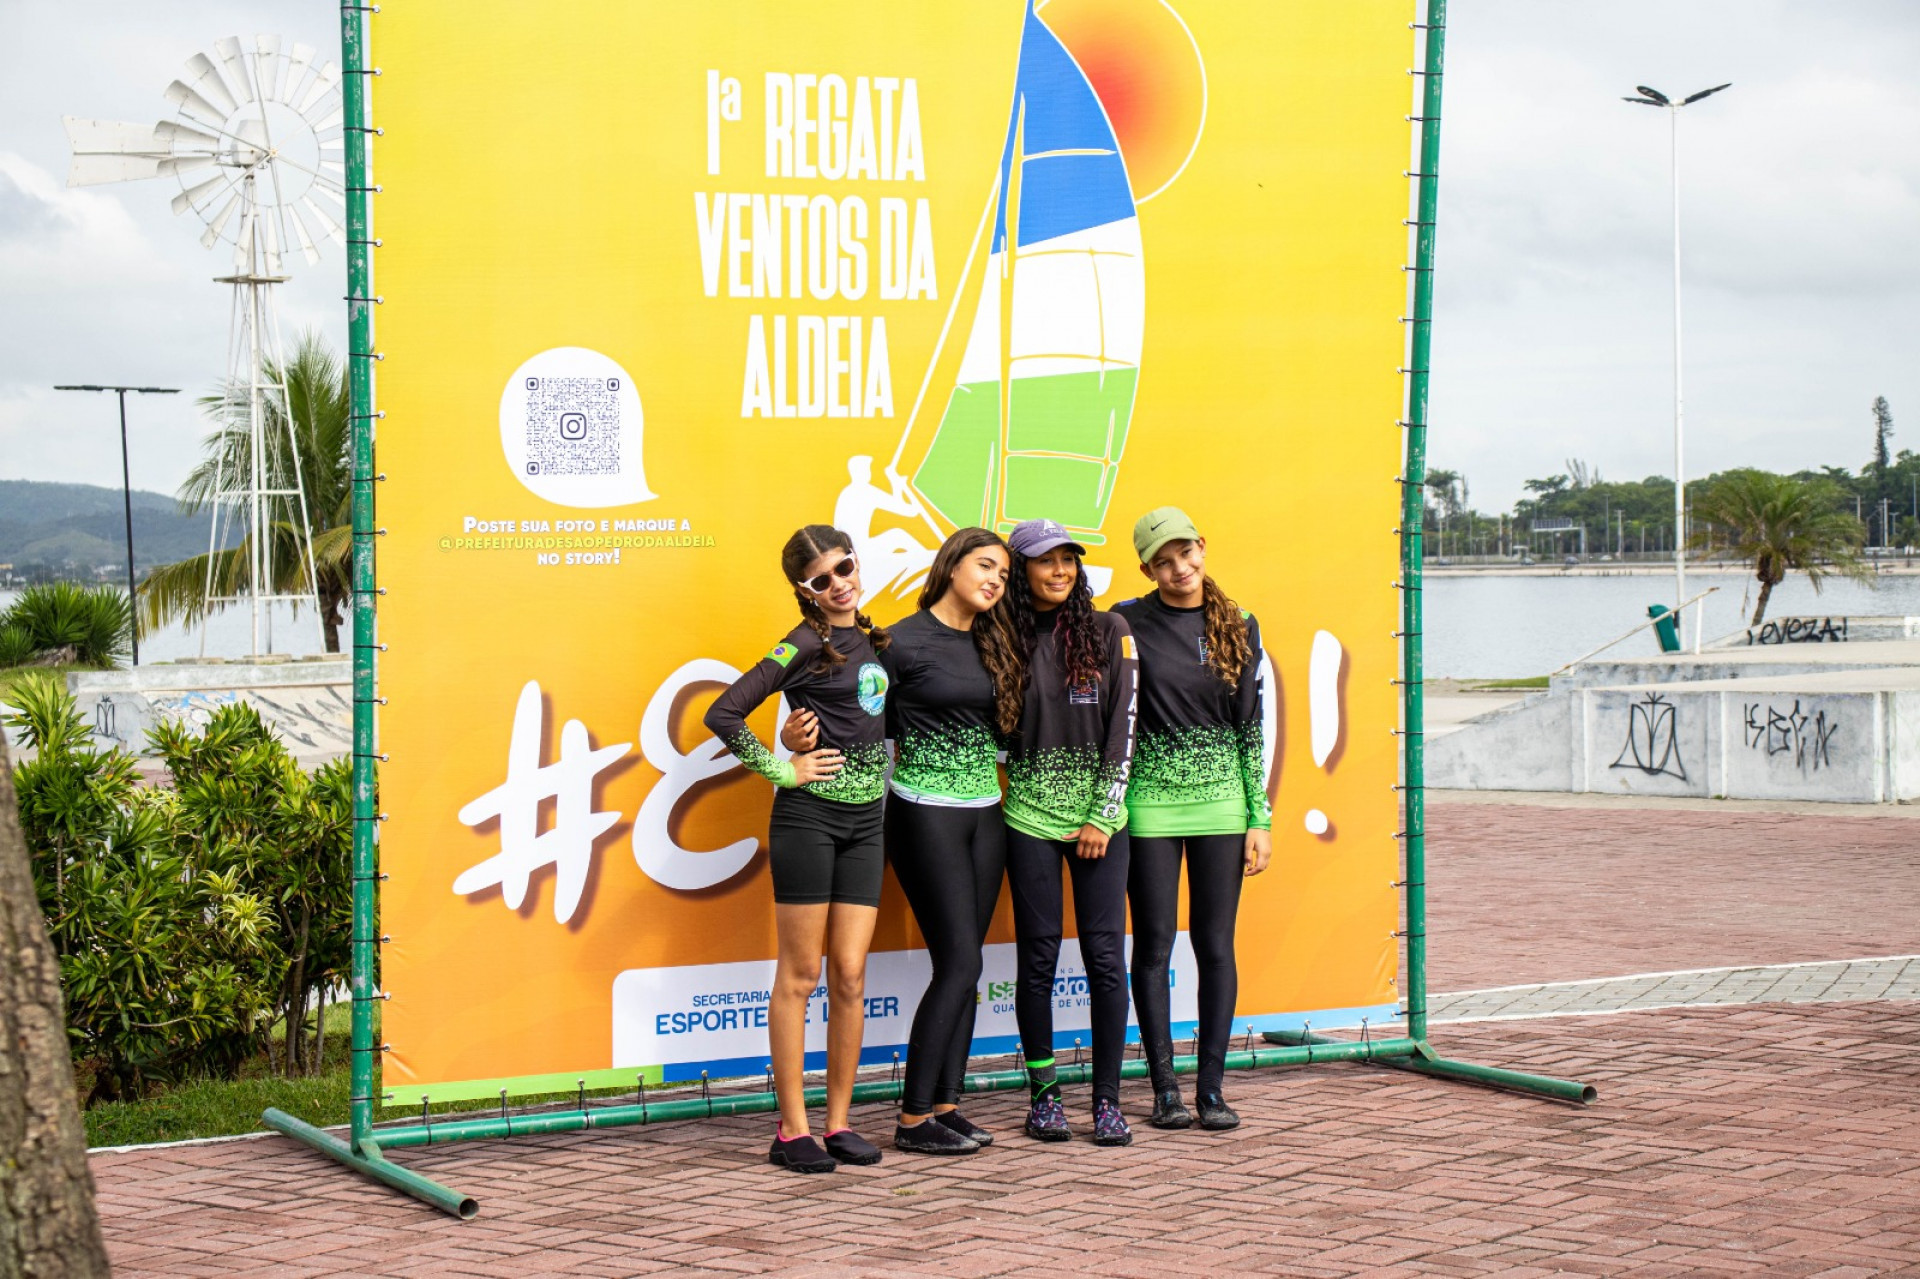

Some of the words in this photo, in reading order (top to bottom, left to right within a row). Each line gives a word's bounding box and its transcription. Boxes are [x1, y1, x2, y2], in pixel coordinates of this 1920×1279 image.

[765, 71, 926, 182] REGATA
[694, 191, 869, 301] VENTOS
[879, 197, 938, 300] DA
[741, 314, 894, 418] ALDEIA
[520, 520, 550, 532] SUA
[555, 519, 595, 532] FOTO
[600, 520, 609, 531] E
[614, 519, 676, 531] MARQUE
[680, 519, 691, 531] A
[437, 534, 716, 552] @PREFEITURADESAOPEDRODAALDEIA
[537, 553, 560, 565] NO
[565, 547, 620, 564] STORY!
[692, 990, 771, 1007] SECRETARIA
